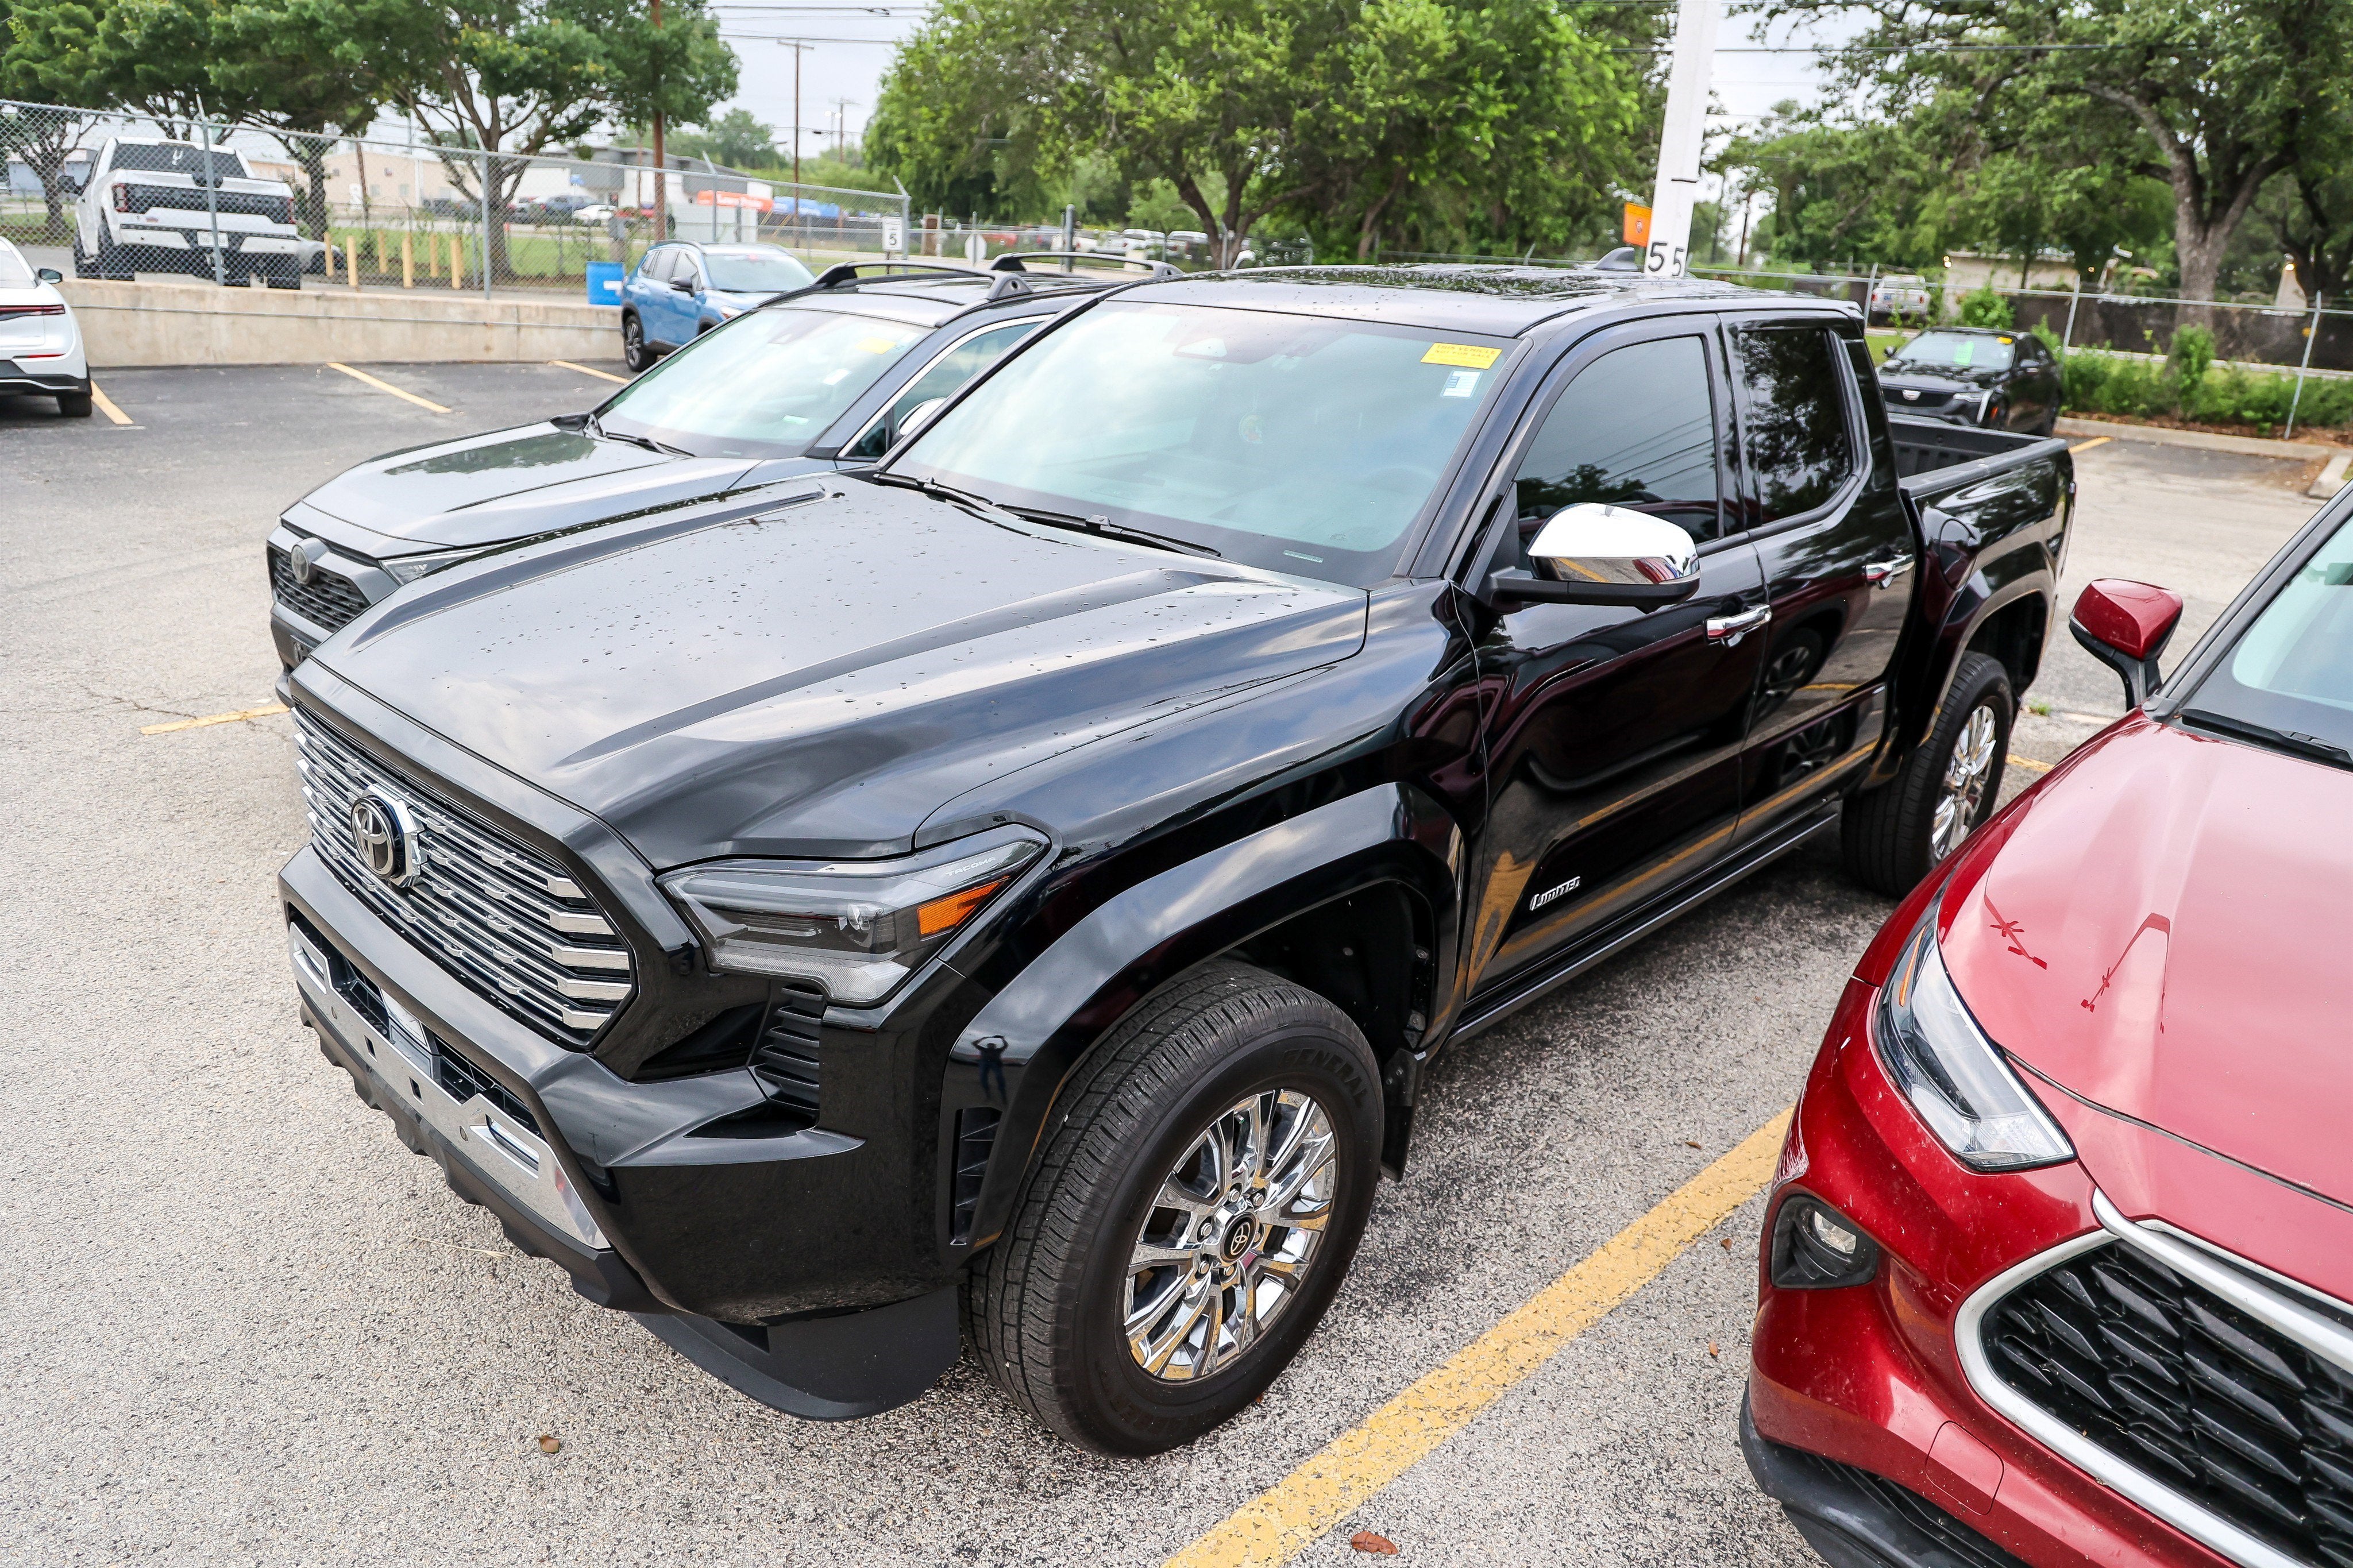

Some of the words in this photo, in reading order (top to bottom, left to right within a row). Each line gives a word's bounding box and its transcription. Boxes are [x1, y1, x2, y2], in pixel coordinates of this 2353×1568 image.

[889, 233, 897, 246] 5
[1648, 241, 1668, 272] 5
[1672, 247, 1684, 277] 5
[1459, 347, 1495, 355] VEHICLE
[945, 856, 996, 876] TACOMA
[1279, 1047, 1368, 1109] GENERAL
